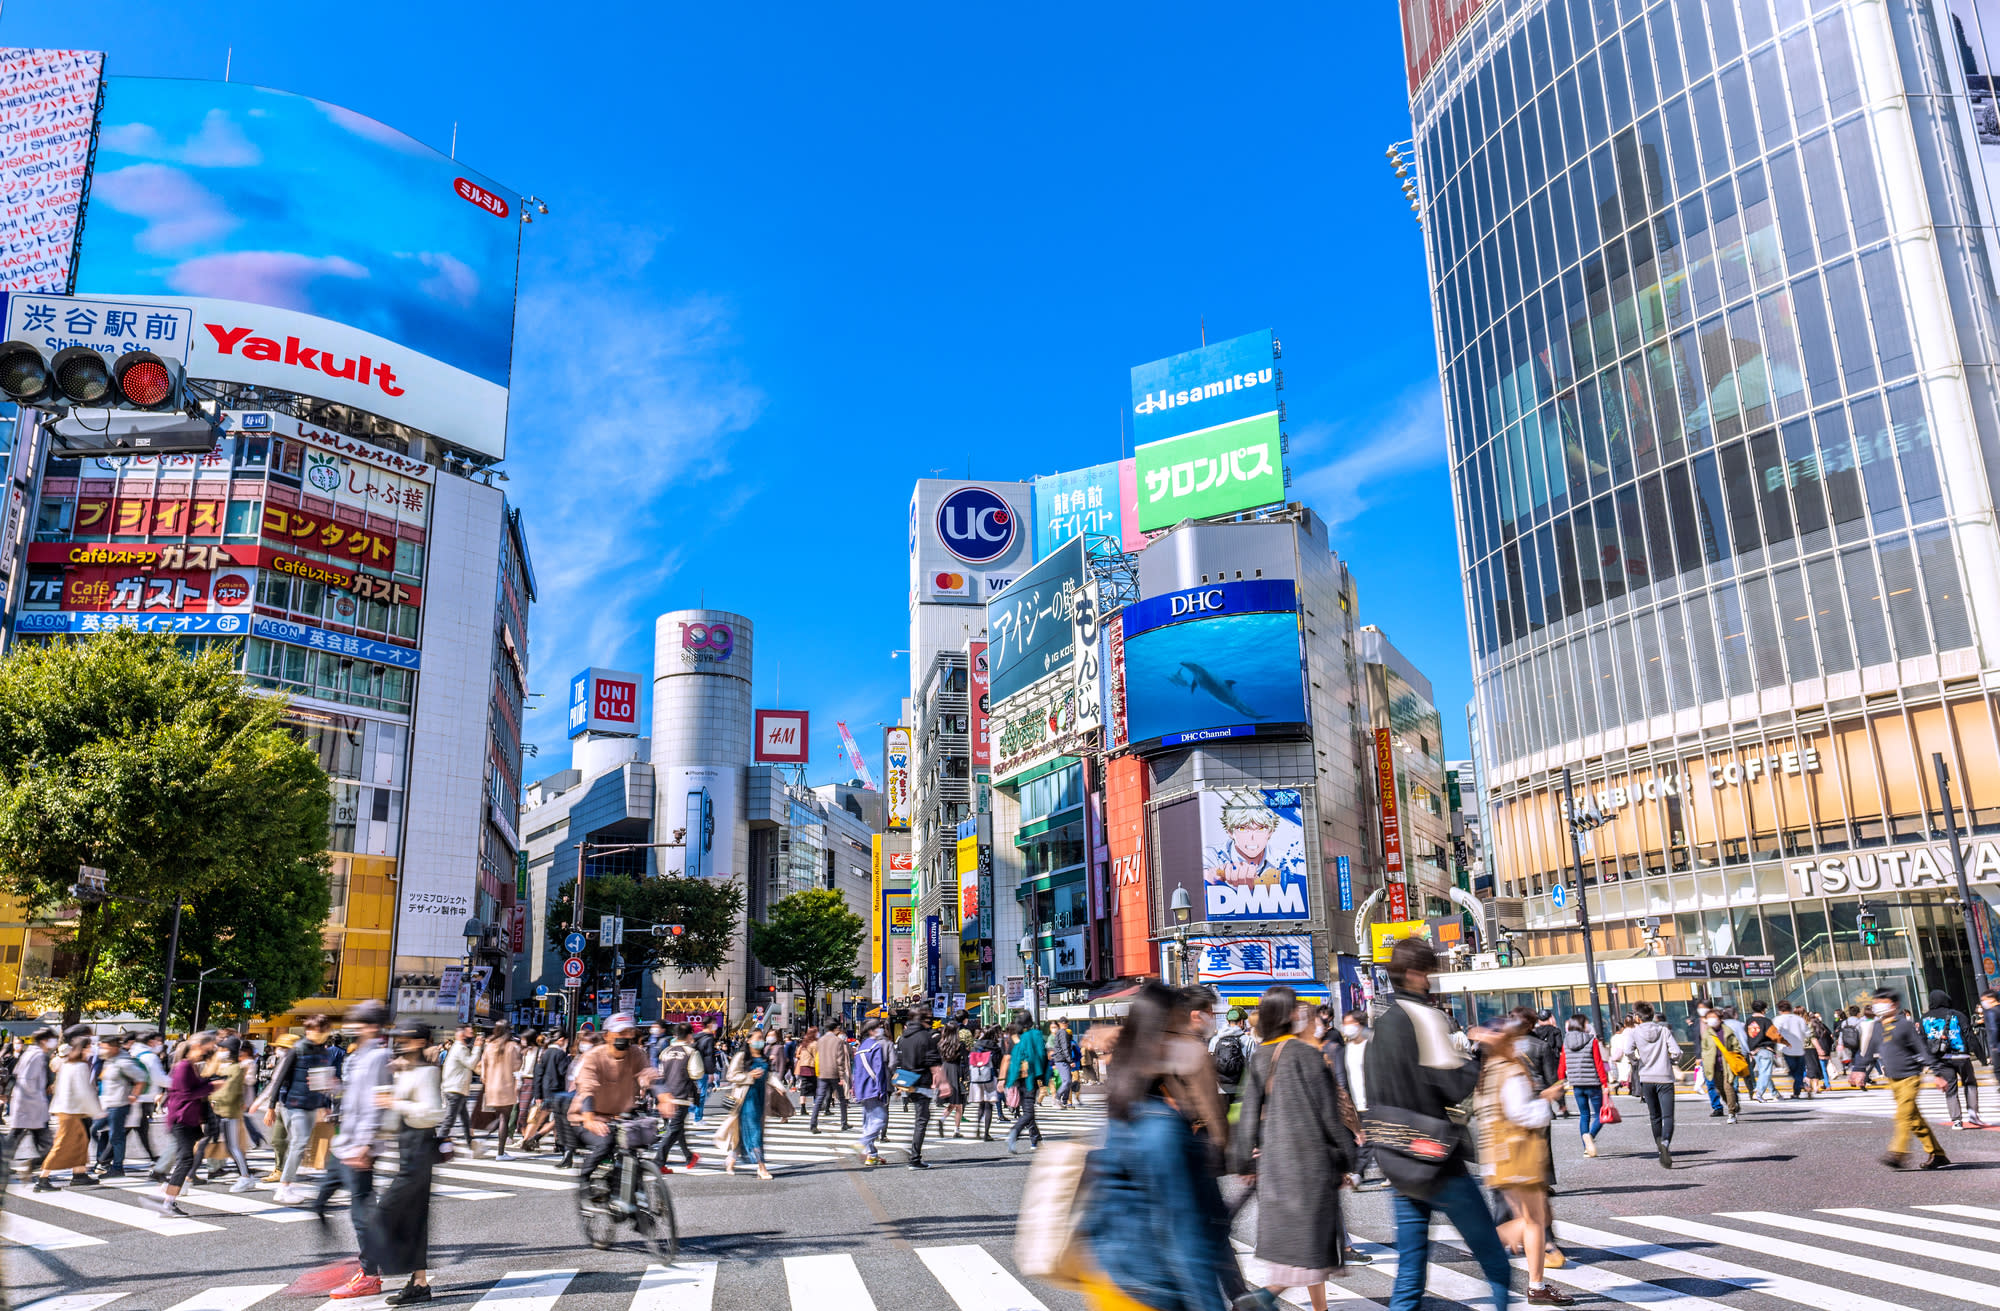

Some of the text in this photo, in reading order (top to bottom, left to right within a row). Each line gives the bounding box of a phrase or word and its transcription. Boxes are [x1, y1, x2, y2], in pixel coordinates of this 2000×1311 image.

[13, 159, 60, 178] VISION
[7, 203, 28, 217] HIT
[460, 182, 504, 213] ミルミル
[25, 211, 45, 224] HIT
[48, 242, 70, 256] HIT
[23, 304, 178, 341] 渋谷駅前
[203, 323, 405, 397] Yakult
[298, 422, 428, 476] しゃぶしゃぶバイキング
[1145, 443, 1273, 503] サロンパス
[348, 469, 424, 512] しゃぶ葉
[1054, 485, 1103, 515] 龍角散
[79, 500, 217, 527] プライス
[264, 507, 391, 560] コンタクト
[69, 545, 230, 569] Caféレストラン ガスト
[30, 581, 63, 599] 7F
[71, 580, 110, 595] Café
[111, 577, 200, 609] ガスト
[218, 588, 246, 598] ガスト
[274, 557, 409, 604] Caféレストラン ガスト
[1170, 590, 1224, 617] DHC
[25, 615, 67, 627] AEON
[82, 614, 238, 632] 英会話イーオン 6F
[260, 620, 299, 639] AEON
[310, 629, 417, 664] 英会話イーオン
[679, 622, 734, 661] 109
[681, 653, 713, 662] SHIBUYA
[1076, 589, 1099, 723] もんじゃ
[600, 684, 628, 700] UNI
[600, 702, 630, 717] QLO
[769, 727, 795, 744] H&M
[1181, 729, 1231, 742] DHC Channel
[1378, 732, 1393, 810] クスリのことなら
[1711, 748, 1819, 788] COFFEE
[1384, 815, 1401, 866] 三千里
[1790, 841, 2000, 894] TSUTAYA
[408, 904, 467, 916] デザイン製作中
[409, 893, 467, 904] ツツミプロジェクト
[1206, 883, 1306, 915] DMM
[1198, 944, 1300, 971] 堂書店
